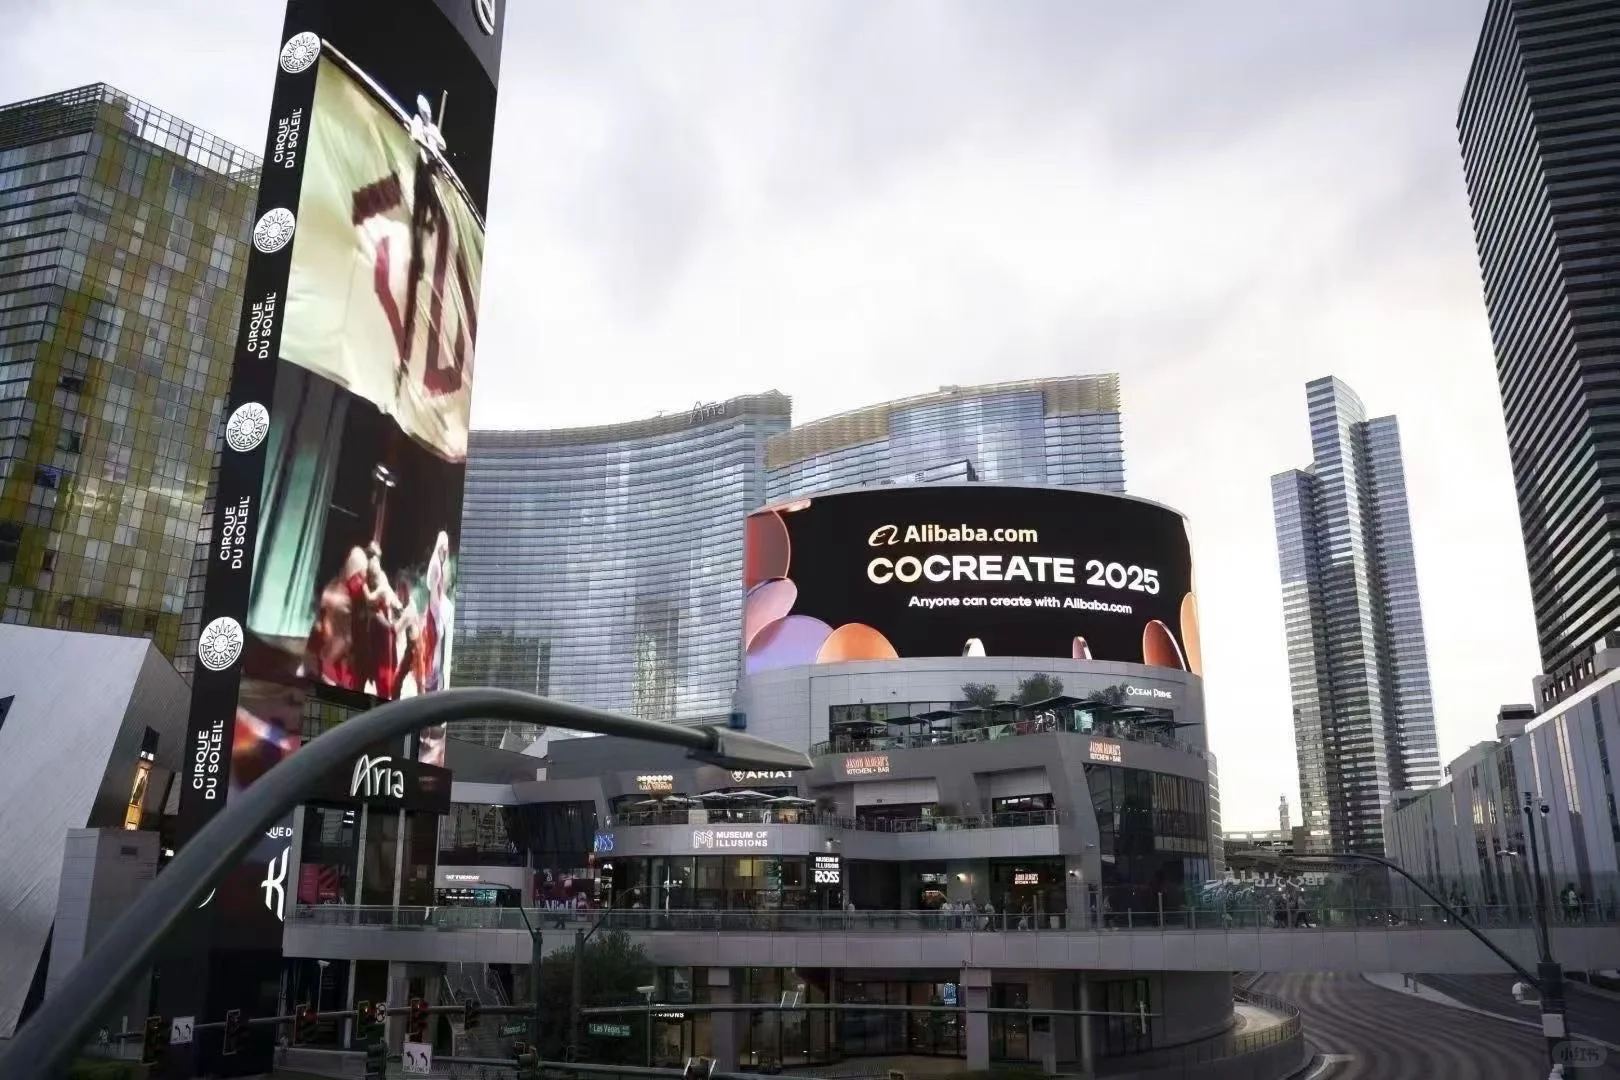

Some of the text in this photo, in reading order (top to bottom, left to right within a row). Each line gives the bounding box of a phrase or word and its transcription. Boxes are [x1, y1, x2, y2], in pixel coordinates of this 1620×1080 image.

[274, 117, 290, 163] CIRQUE
[285, 107, 302, 169] DU SOLEIL
[247, 302, 264, 352] CIRQUE
[258, 292, 276, 359] DU SOLEIL
[220, 506, 237, 561] CIRQUE
[231, 495, 250, 569] DU SOLEIL
[904, 523, 1038, 543] Alibaba.com
[867, 554, 1160, 595] COCREATE 2025
[908, 596, 1132, 614] Anyone can create with Alibaba.com
[193, 730, 210, 790] CIRQUE
[205, 719, 224, 800] DU SOLEIL
[350, 754, 404, 799] Aria
[716, 830, 769, 839] MUSEUM OF
[716, 839, 768, 847] ILLUSIONS
